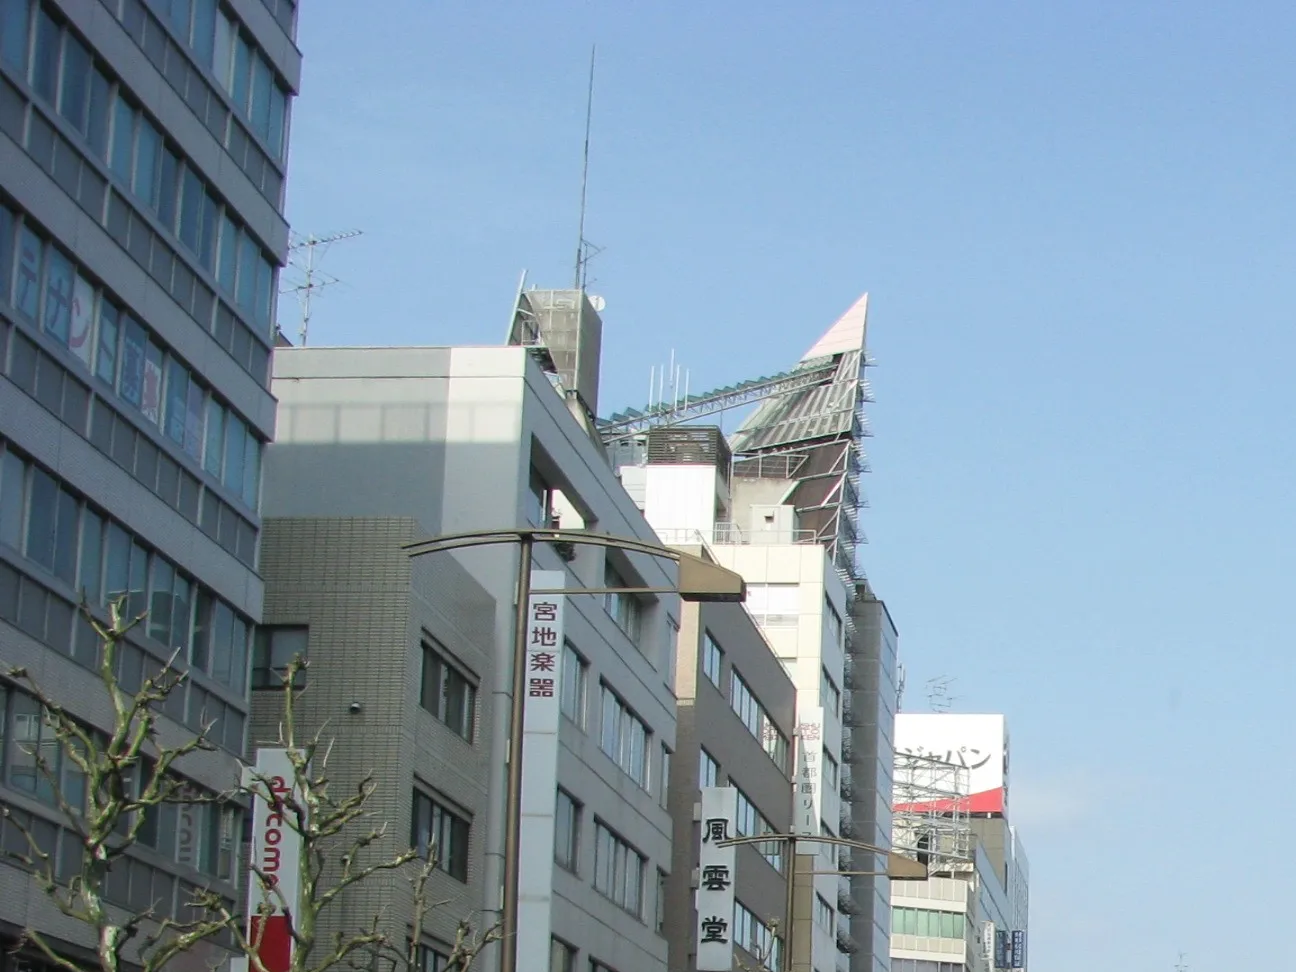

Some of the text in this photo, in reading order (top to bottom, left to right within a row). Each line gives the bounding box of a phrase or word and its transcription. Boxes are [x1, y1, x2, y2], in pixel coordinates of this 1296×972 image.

[529, 602, 557, 697] 宮地楽器
[700, 818, 731, 945] 風雲堂
